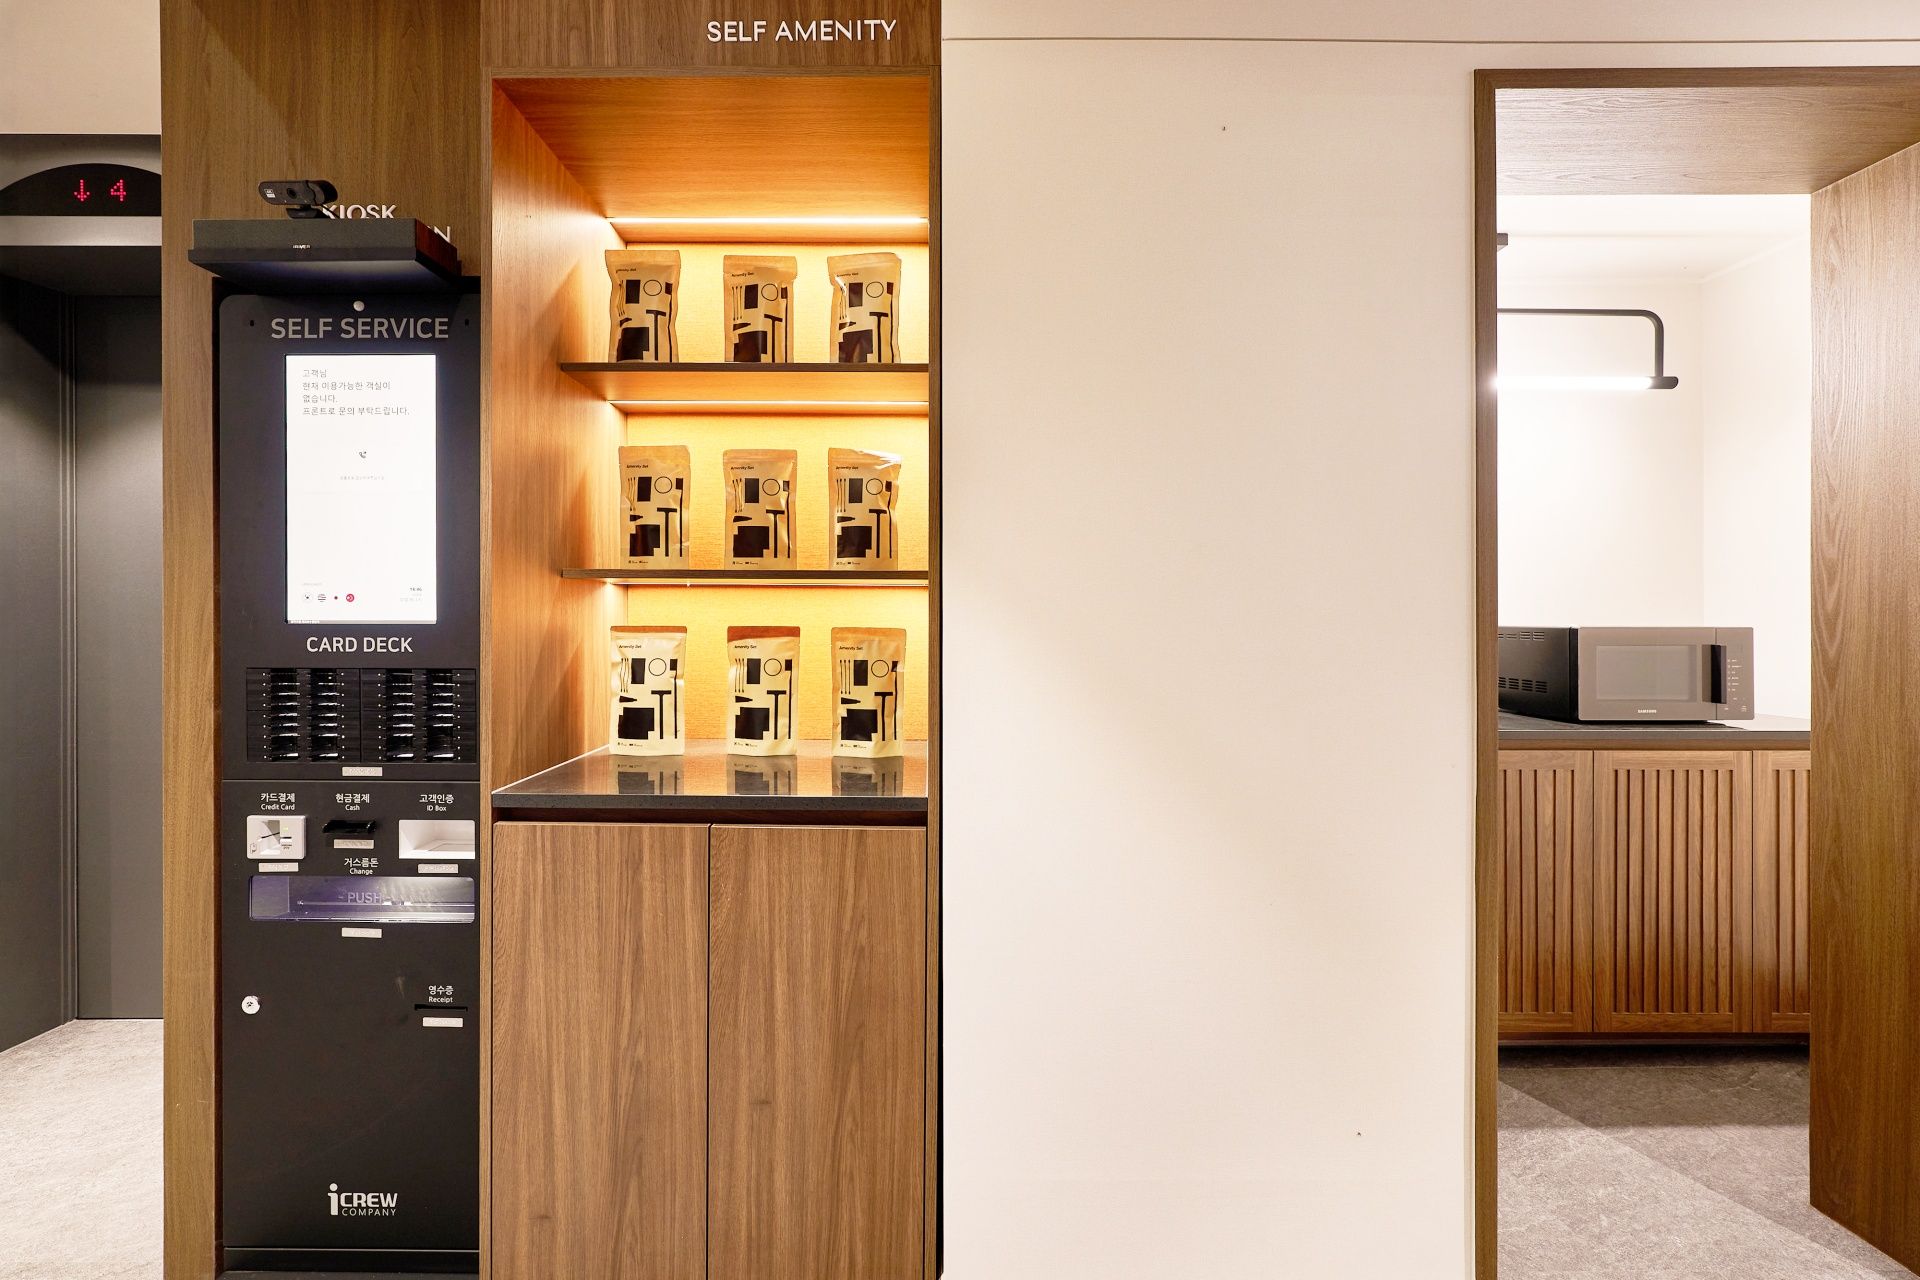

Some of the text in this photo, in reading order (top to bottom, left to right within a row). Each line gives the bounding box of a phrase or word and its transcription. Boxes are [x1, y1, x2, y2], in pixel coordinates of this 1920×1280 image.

[706, 19, 897, 42] SELF AMENITY
[110, 179, 127, 202] 4
[271, 317, 449, 339] SELF SERVICE
[302, 369, 327, 378] 고객님
[366, 381, 391, 391] 객실이
[306, 636, 413, 653] CARD DECK
[260, 792, 296, 803] 카드결제
[335, 793, 370, 804] 현금결제
[419, 794, 455, 804] 고객인증
[260, 803, 296, 811] Credit Card
[344, 857, 379, 868] 거스름돈
[349, 868, 374, 876] Change
[347, 892, 382, 904] PUSH
[428, 985, 454, 996] 영수증
[341, 1208, 397, 1217] COMPANY
